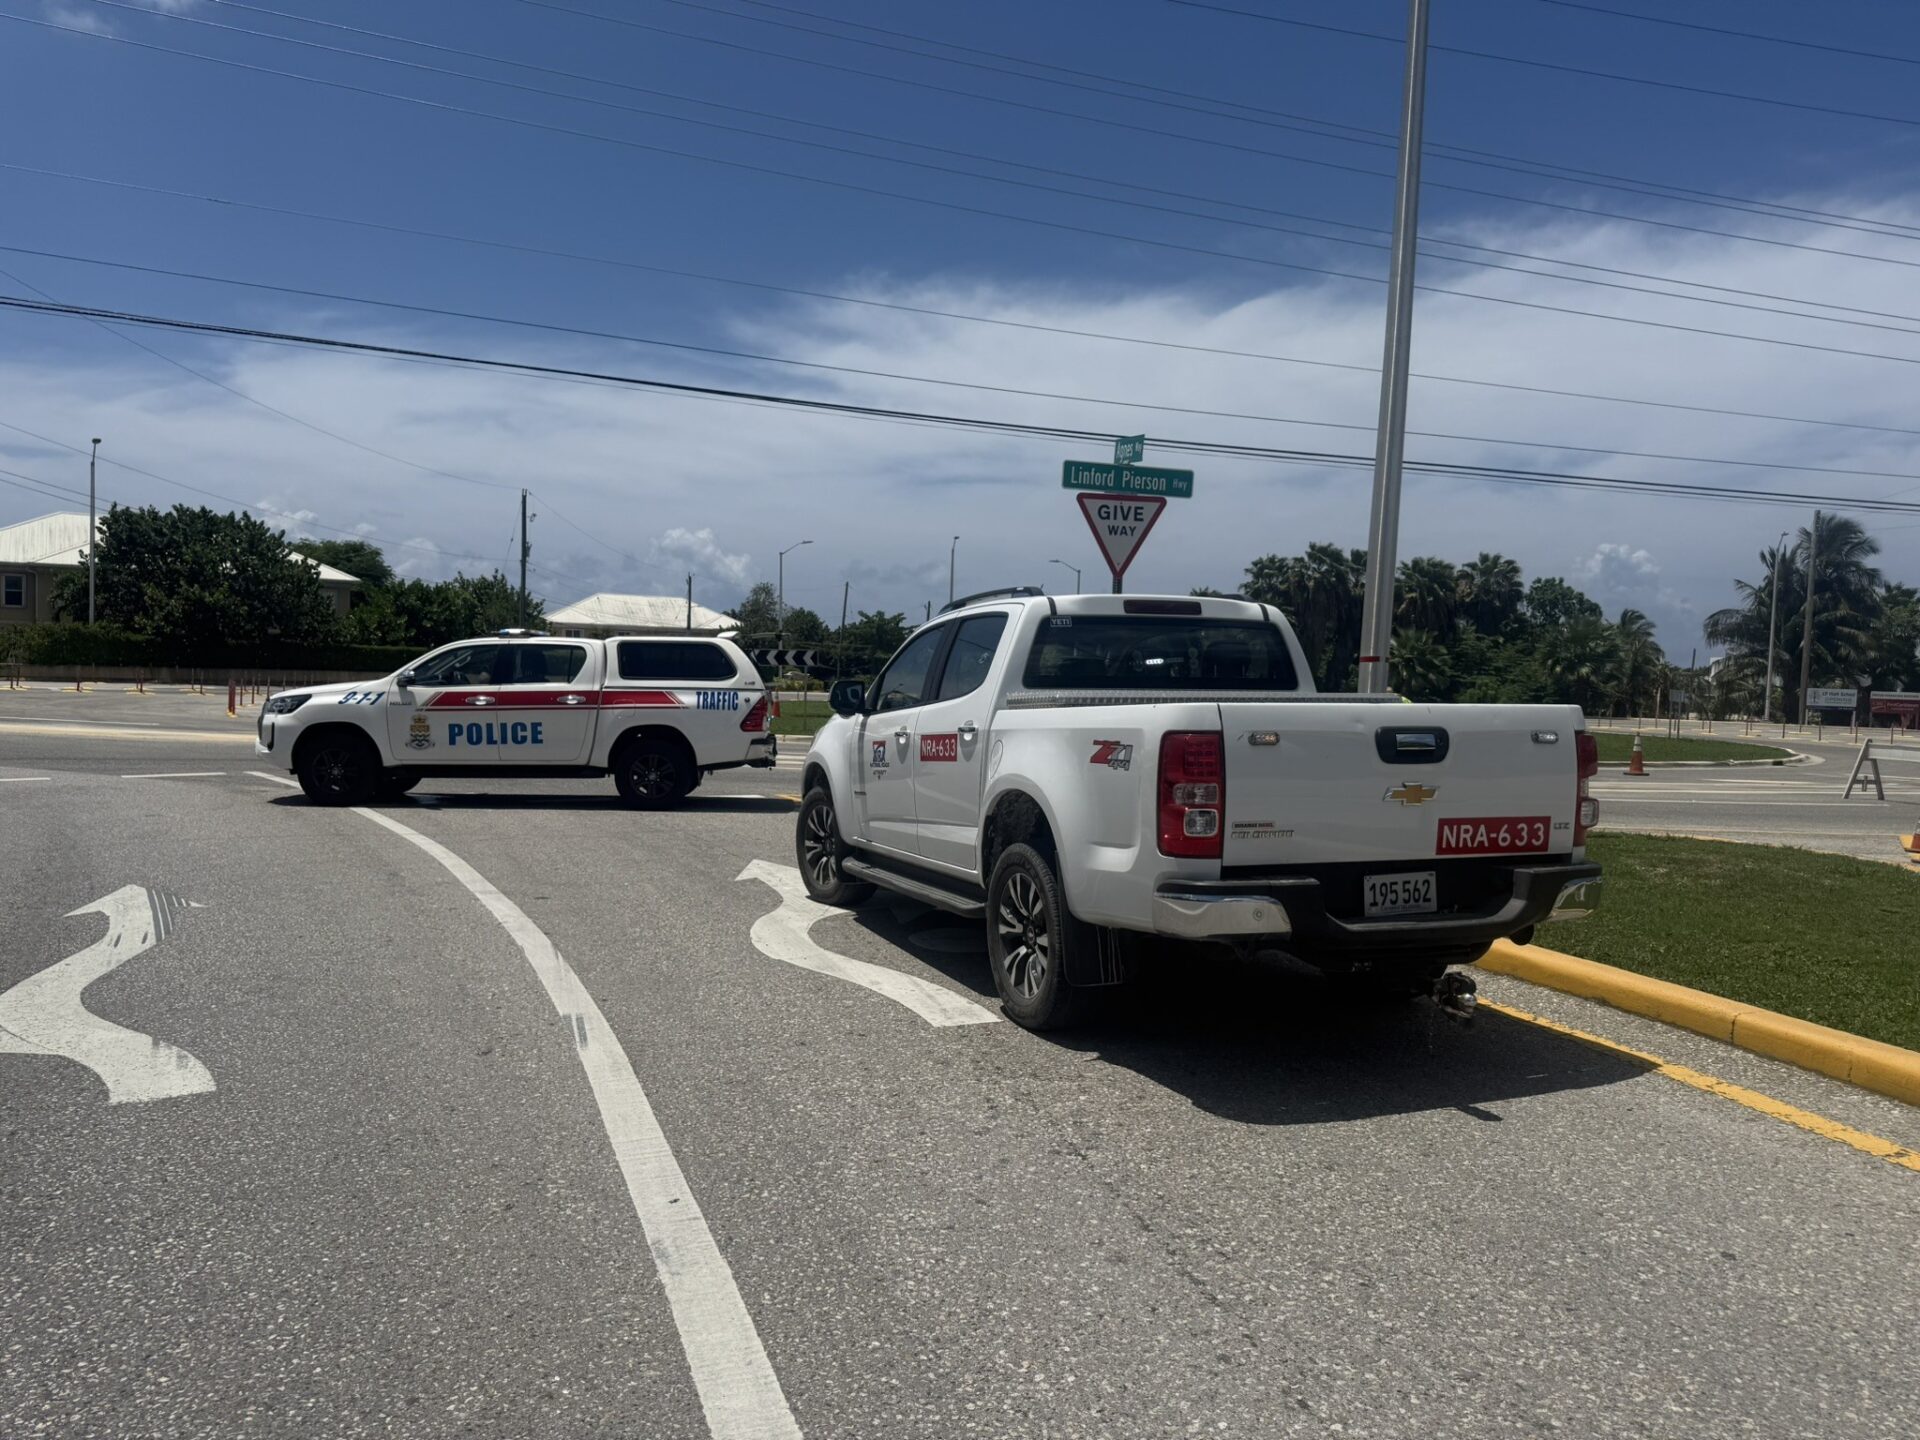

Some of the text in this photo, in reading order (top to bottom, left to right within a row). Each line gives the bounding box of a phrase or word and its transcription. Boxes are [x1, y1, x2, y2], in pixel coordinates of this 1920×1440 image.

[1071, 466, 1188, 491] Linford Pierson Hwy
[1097, 504, 1145, 522] GIVE
[1107, 525, 1137, 537] WAY
[338, 691, 386, 705] 9-1-1
[696, 691, 739, 711] TRAFFIC
[448, 722, 544, 746] POLICE
[921, 738, 957, 757] NRA-633
[1442, 823, 1545, 848] NRA-633
